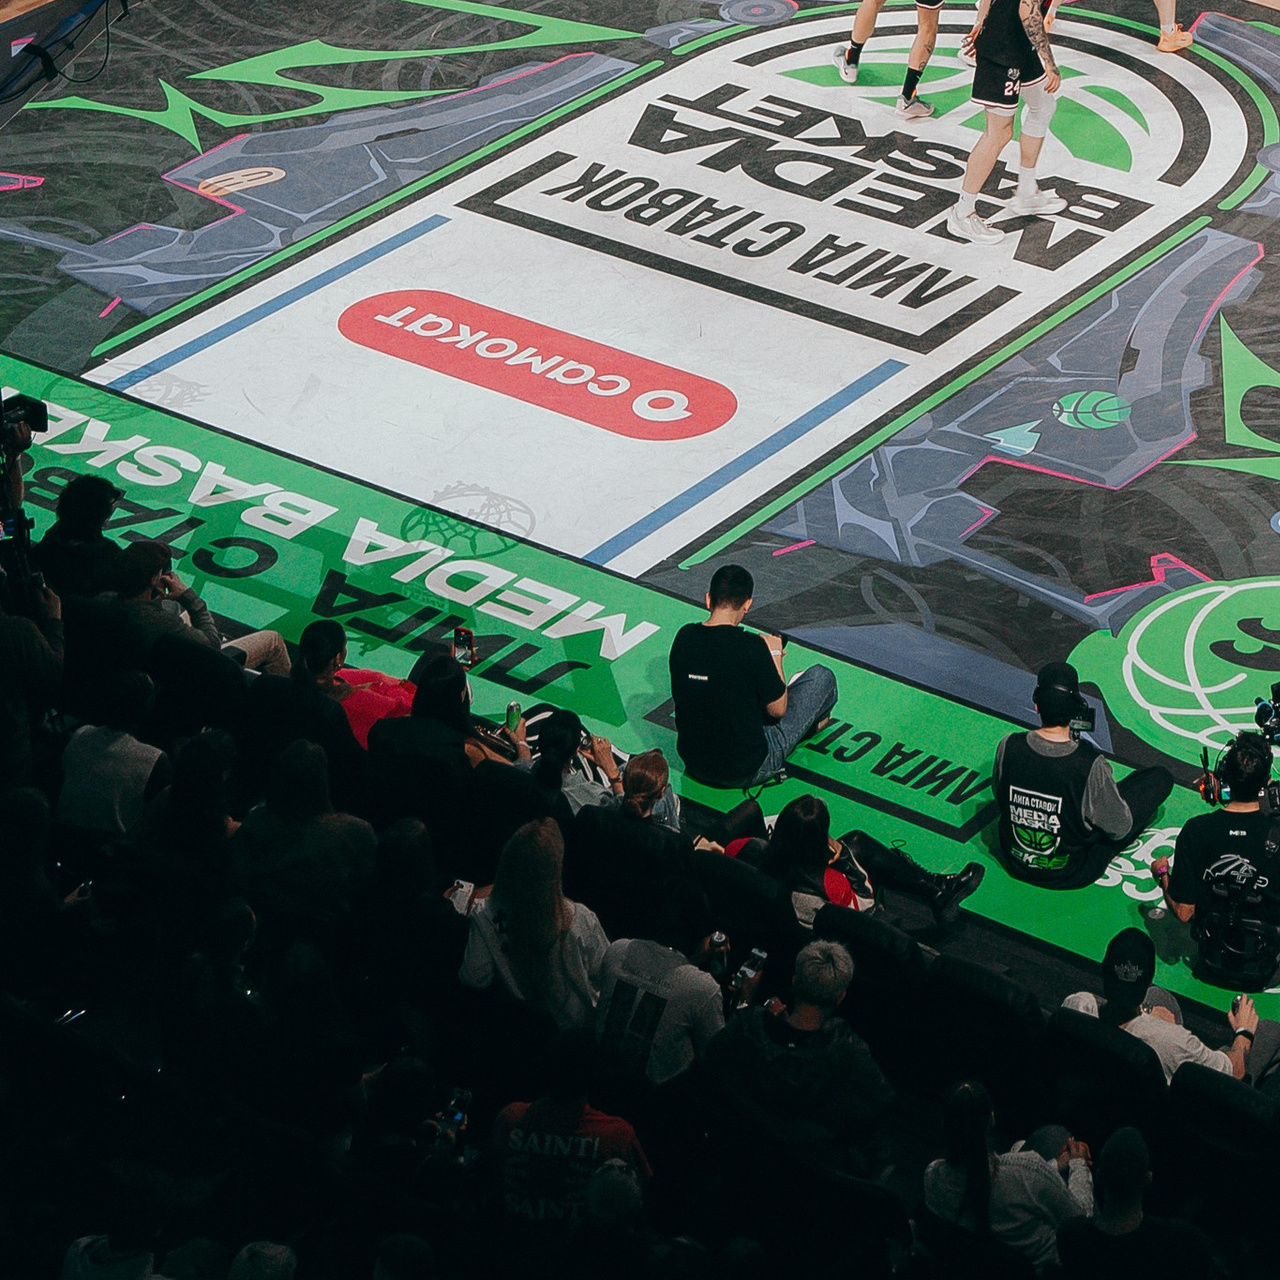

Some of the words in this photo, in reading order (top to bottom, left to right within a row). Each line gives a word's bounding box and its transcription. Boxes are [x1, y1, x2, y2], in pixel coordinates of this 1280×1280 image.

[1003, 80, 1020, 96] 24
[544, 161, 810, 260] СТАВОК
[627, 101, 1107, 272] MEDIA
[787, 232, 979, 310] ЛИГА
[371, 303, 634, 397] самокат
[341, 518, 661, 662] MEDIA
[1009, 804, 1061, 826] MEDIA
[1010, 813, 1061, 835] BASKET
[1013, 793, 1030, 807] ЛИГА
[1030, 797, 1058, 813] СТАВОК
